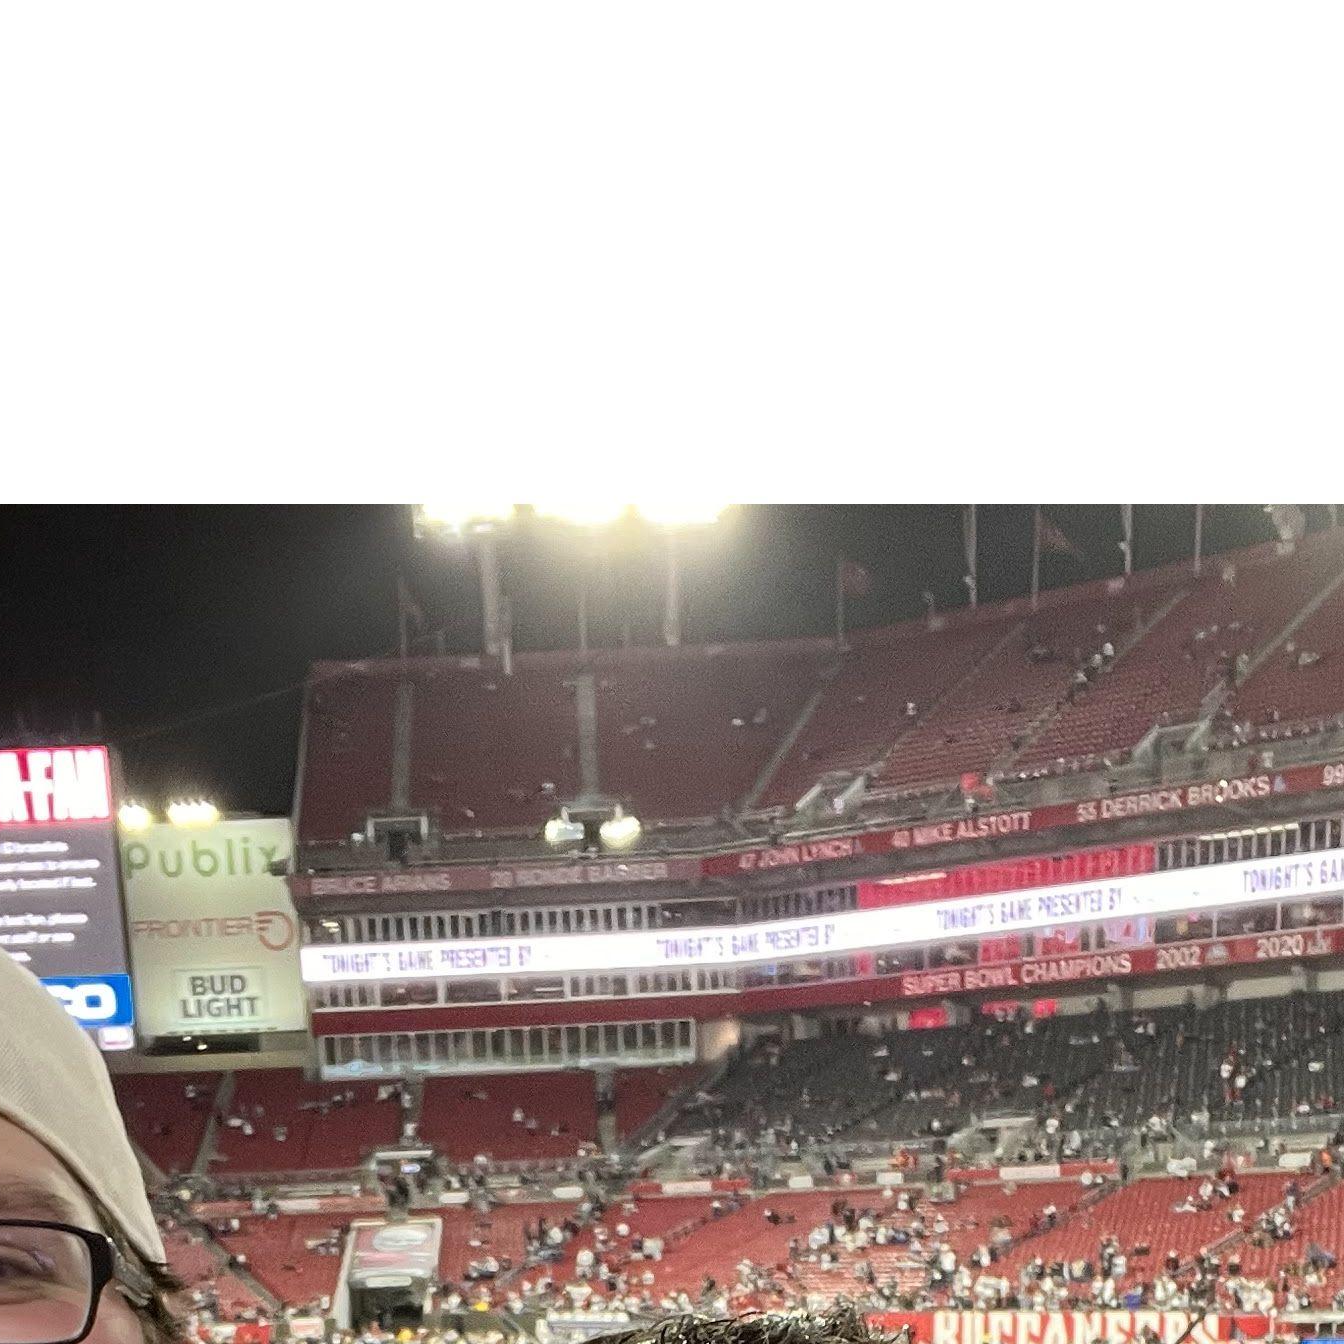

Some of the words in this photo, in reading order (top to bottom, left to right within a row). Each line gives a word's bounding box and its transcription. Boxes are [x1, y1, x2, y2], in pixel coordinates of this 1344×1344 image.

[1323, 763, 1344, 785] 99
[1099, 790, 1183, 820] DERRICK
[1188, 776, 1271, 807] BROOKS
[914, 822, 955, 846] MIKE
[956, 811, 1033, 839] ALSTOTT
[124, 836, 279, 880] Publix
[758, 845, 800, 868] JOHN
[802, 838, 854, 863] LYNCH
[1243, 861, 1313, 894] TONIGHT'S
[903, 970, 960, 997] SUPER
[965, 966, 1017, 990] BOWL
[1022, 953, 1133, 985] CHAMPIONS
[1156, 945, 1202, 970] 2002
[1256, 934, 1304, 958] 2020
[188, 974, 248, 997] BUD
[179, 996, 260, 1019] LIGHT
